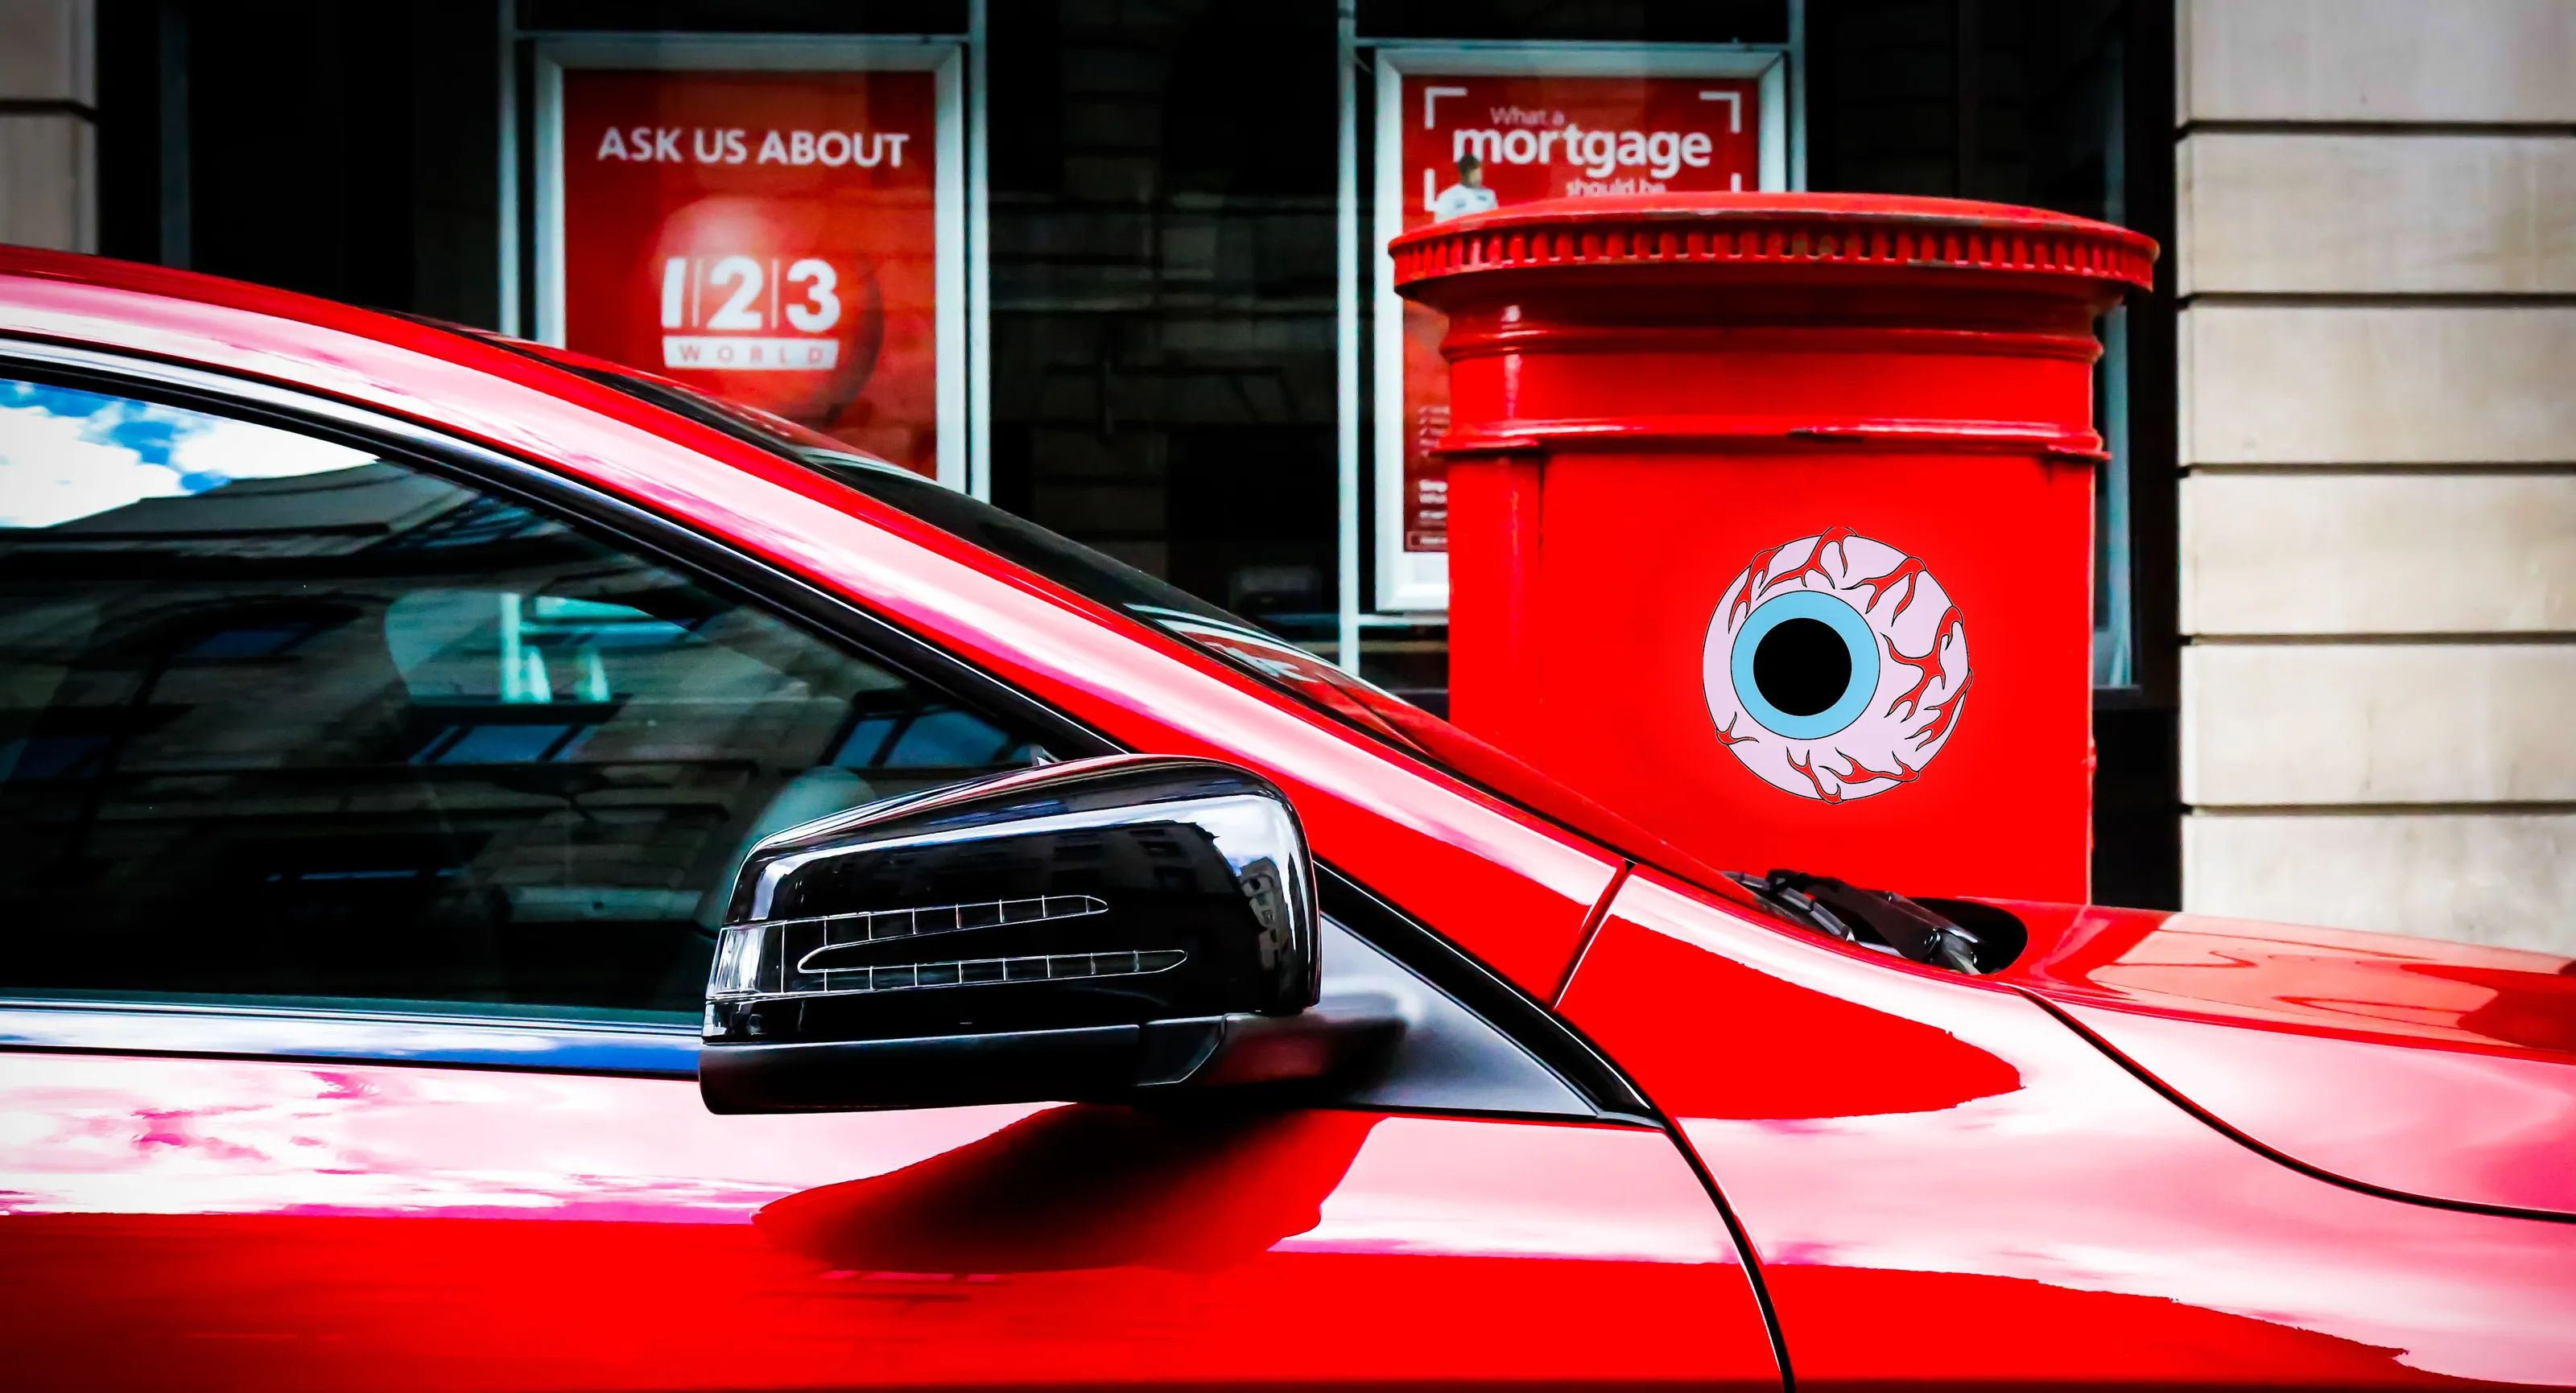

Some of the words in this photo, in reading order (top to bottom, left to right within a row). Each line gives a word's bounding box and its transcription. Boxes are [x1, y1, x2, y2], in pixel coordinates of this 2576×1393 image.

[1551, 110, 1565, 126] a
[597, 126, 681, 161] ASK
[693, 127, 747, 164] US
[758, 130, 910, 167] ABOUT
[1452, 124, 1712, 179] mortgage
[1566, 178, 1634, 197] should
[678, 344, 824, 365] WORLD
